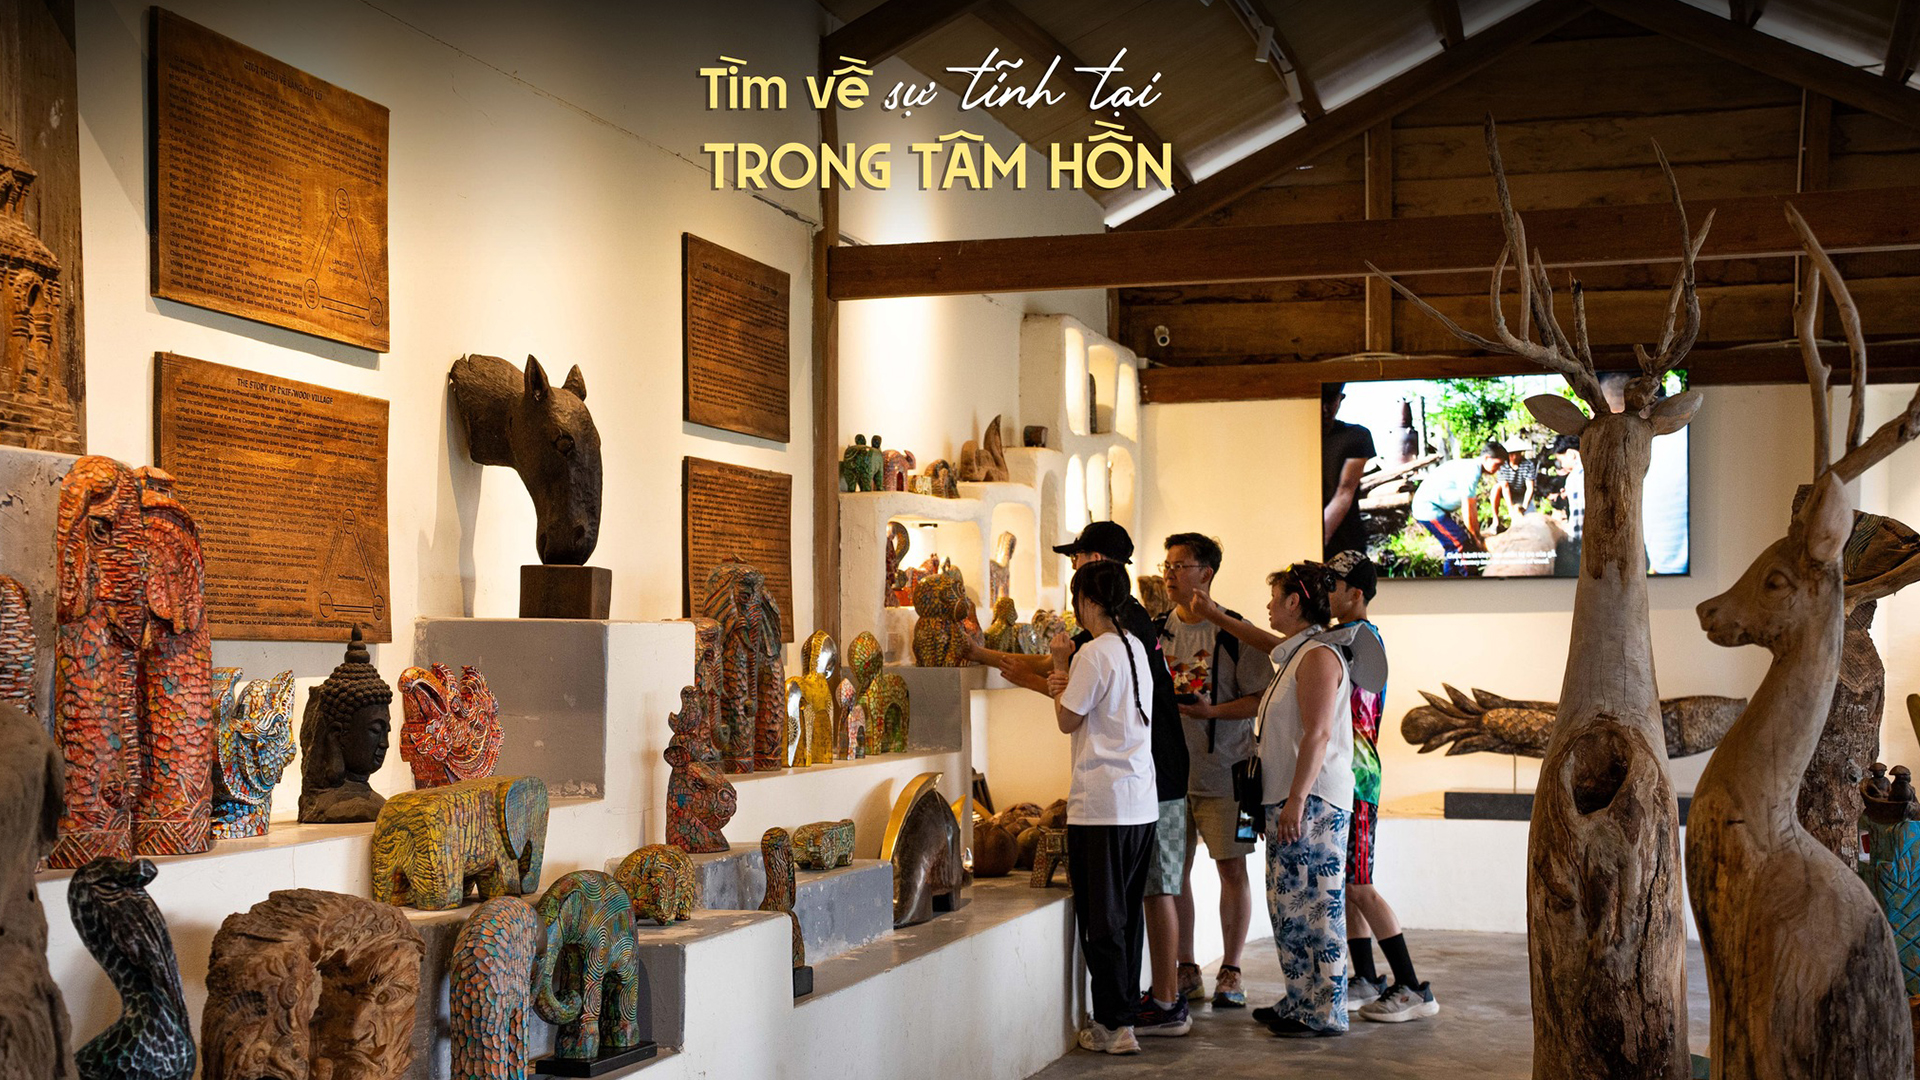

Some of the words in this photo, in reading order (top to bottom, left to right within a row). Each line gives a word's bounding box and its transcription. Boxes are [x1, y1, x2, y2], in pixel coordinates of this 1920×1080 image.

[249, 380, 267, 392] STORY
[269, 384, 276, 393] OF
[311, 393, 333, 405] VILLAGE
